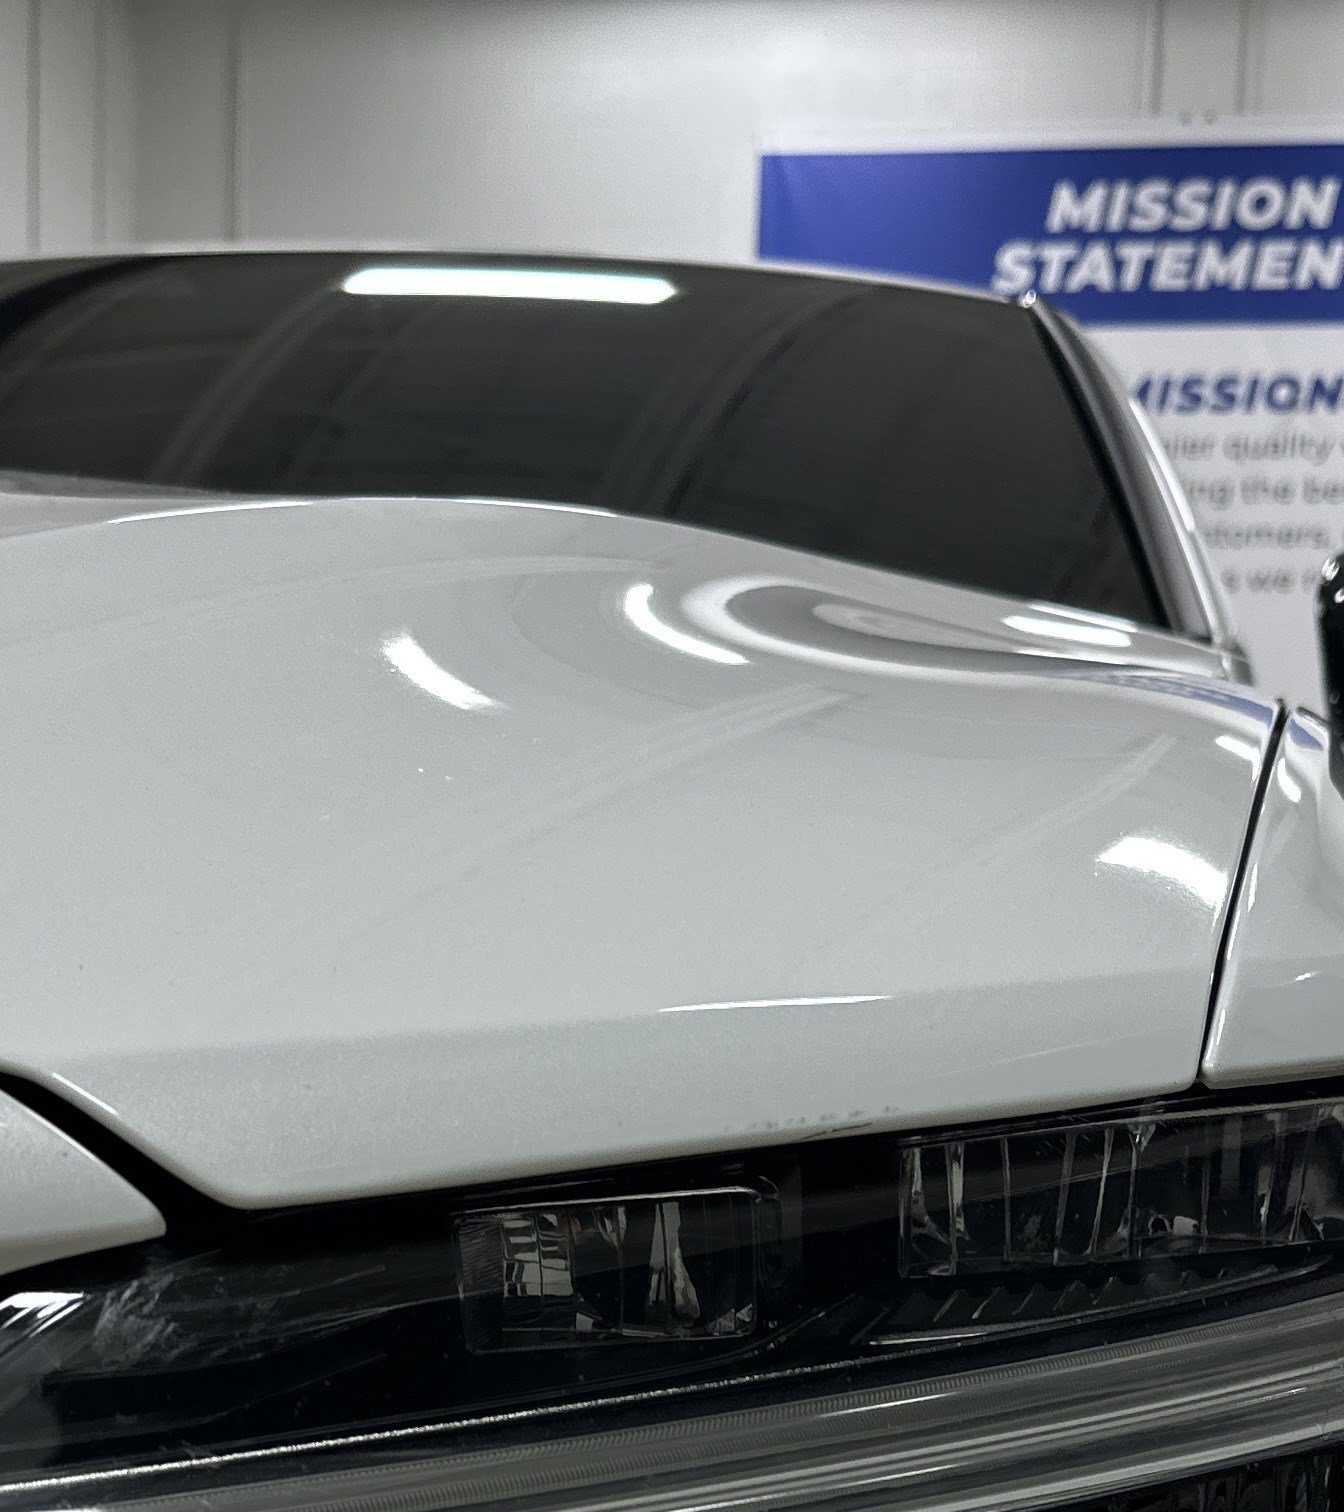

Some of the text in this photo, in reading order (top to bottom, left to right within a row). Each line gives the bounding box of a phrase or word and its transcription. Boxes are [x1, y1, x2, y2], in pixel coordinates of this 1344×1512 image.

[1046, 176, 1342, 233] MISSION
[1222, 430, 1333, 467] quality
[1240, 475, 1295, 506] the
